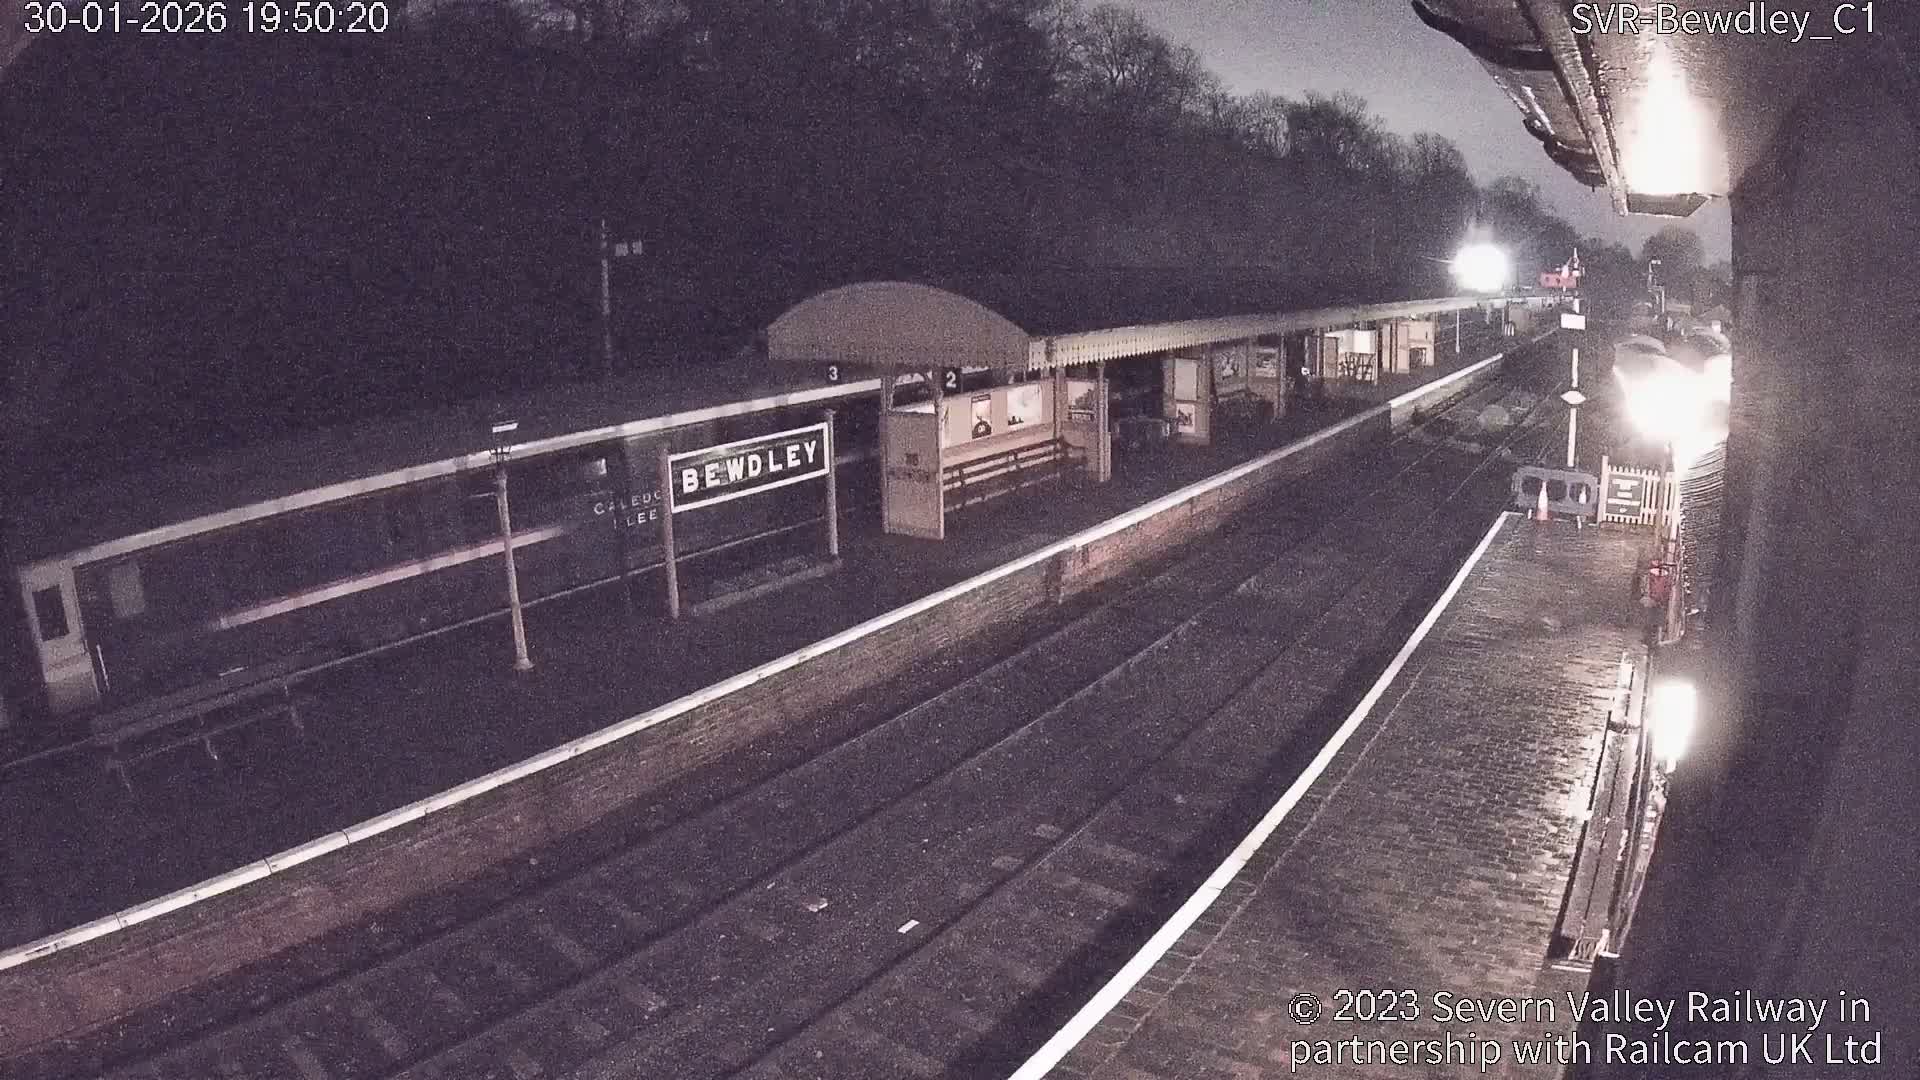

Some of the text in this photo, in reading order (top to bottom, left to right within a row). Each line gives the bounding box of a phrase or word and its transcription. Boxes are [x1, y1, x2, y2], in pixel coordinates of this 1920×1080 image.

[828, 365, 839, 381] 3
[945, 371, 957, 388] 2
[682, 440, 817, 494] BEWDLEY
